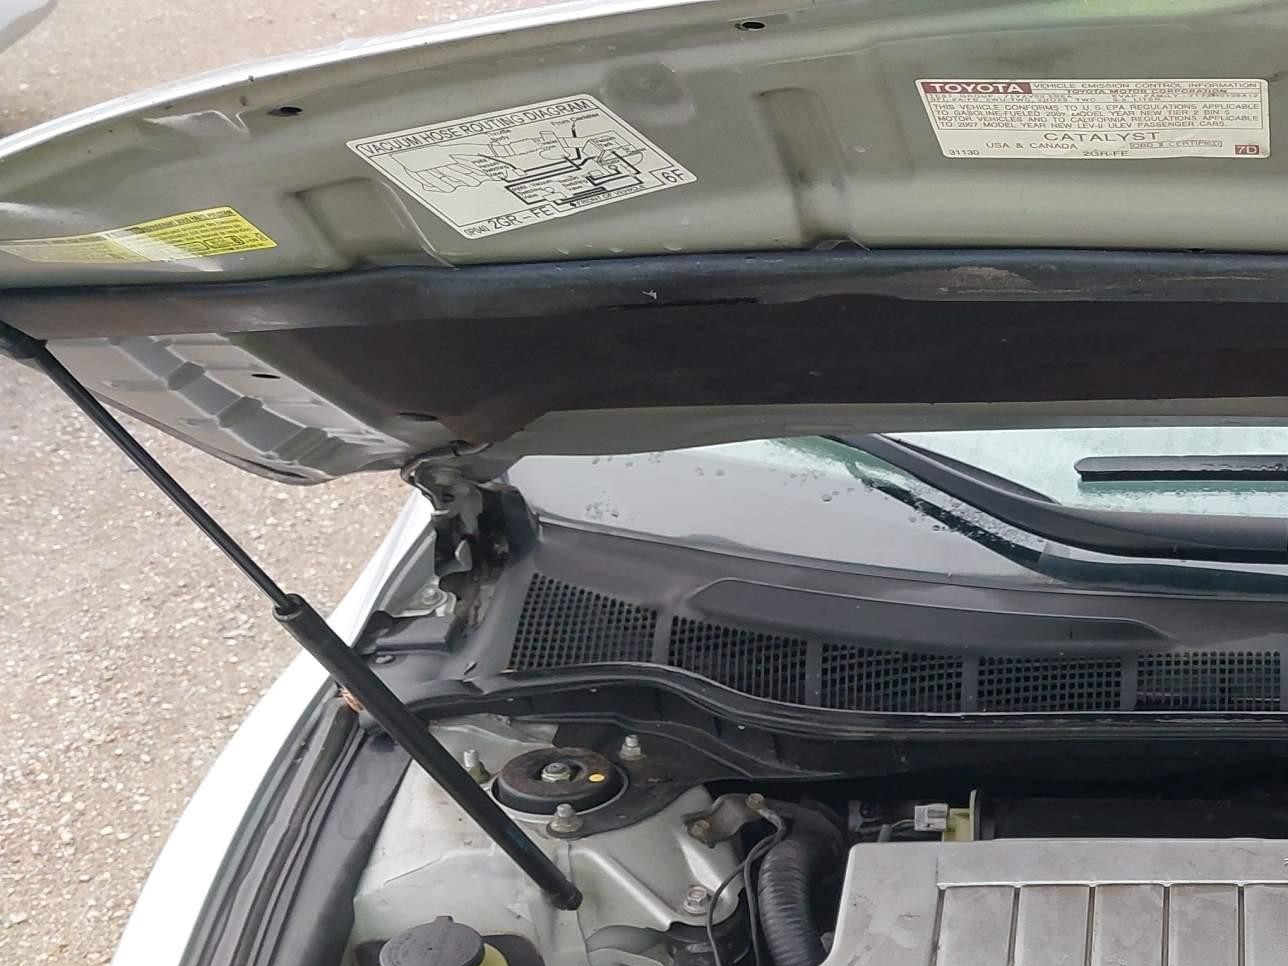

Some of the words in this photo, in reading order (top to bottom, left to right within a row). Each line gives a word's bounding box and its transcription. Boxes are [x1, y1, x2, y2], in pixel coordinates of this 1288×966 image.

[929, 83, 1024, 93] TOYOTA
[360, 136, 423, 154] VACUUM
[419, 128, 460, 143] HOSE
[459, 115, 526, 134] ROUTING
[525, 100, 592, 121] DIAGRAM
[1044, 131, 1160, 142] CATALYST
[1030, 142, 1078, 150] CANADA
[1236, 145, 1257, 154] 7D
[661, 168, 685, 183] 6F
[487, 215, 523, 230] 2GR
[529, 206, 555, 219] FE
